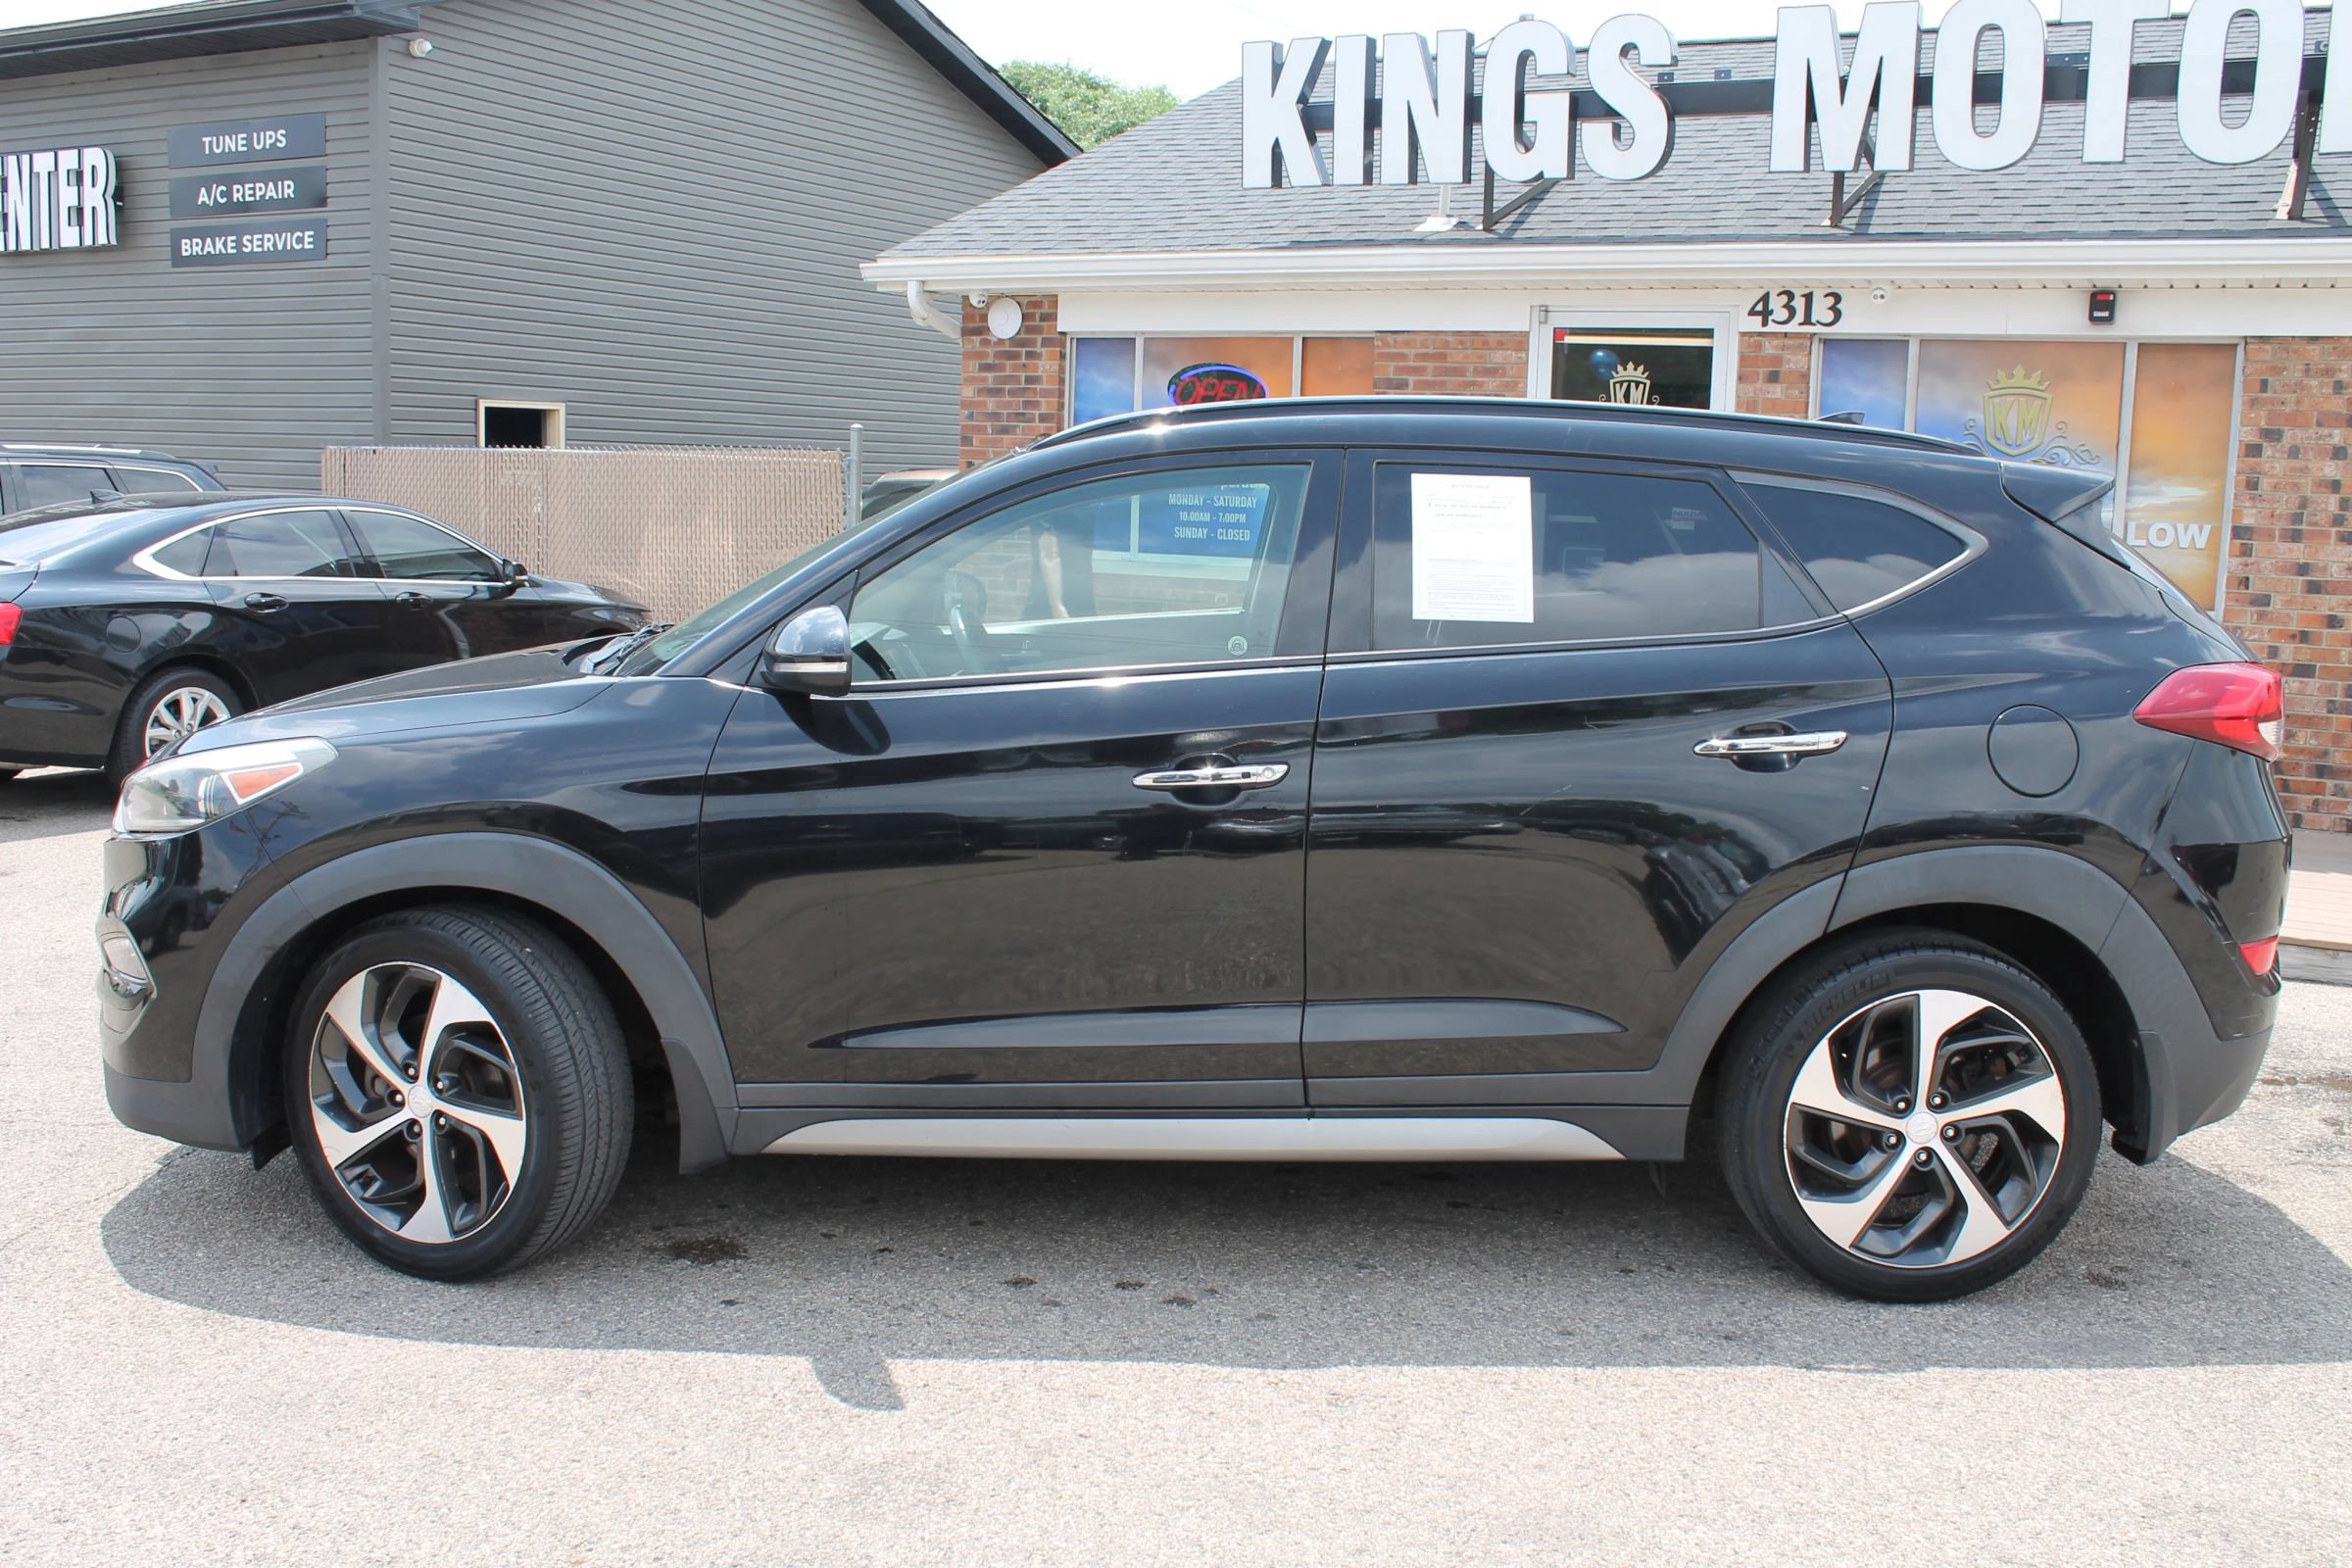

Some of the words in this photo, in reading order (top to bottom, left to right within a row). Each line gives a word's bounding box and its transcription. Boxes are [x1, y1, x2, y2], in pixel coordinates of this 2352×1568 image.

[1242, 14, 1678, 189] KINGS
[202, 134, 247, 155] TUNE
[253, 129, 286, 149] UPS
[0, 147, 118, 252] NTER
[197, 183, 227, 207] A/C
[233, 180, 295, 203] REPAIR
[180, 235, 237, 257] BRAKE
[242, 230, 315, 253] SERVICE
[1747, 289, 1842, 327] 4313
[1175, 375, 1263, 405] OPEN
[1615, 381, 1644, 405] KM
[1992, 398, 2043, 447] KM
[1168, 493, 1204, 507] MONDAY
[1213, 495, 1257, 509] SATURDAY
[1180, 511, 1210, 522] 10:00AM
[1217, 512, 1247, 523] 7:00PM
[1174, 525, 1208, 539] SUNDAY
[1217, 528, 1250, 542] CLOSED
[2127, 521, 2211, 549] LOW
